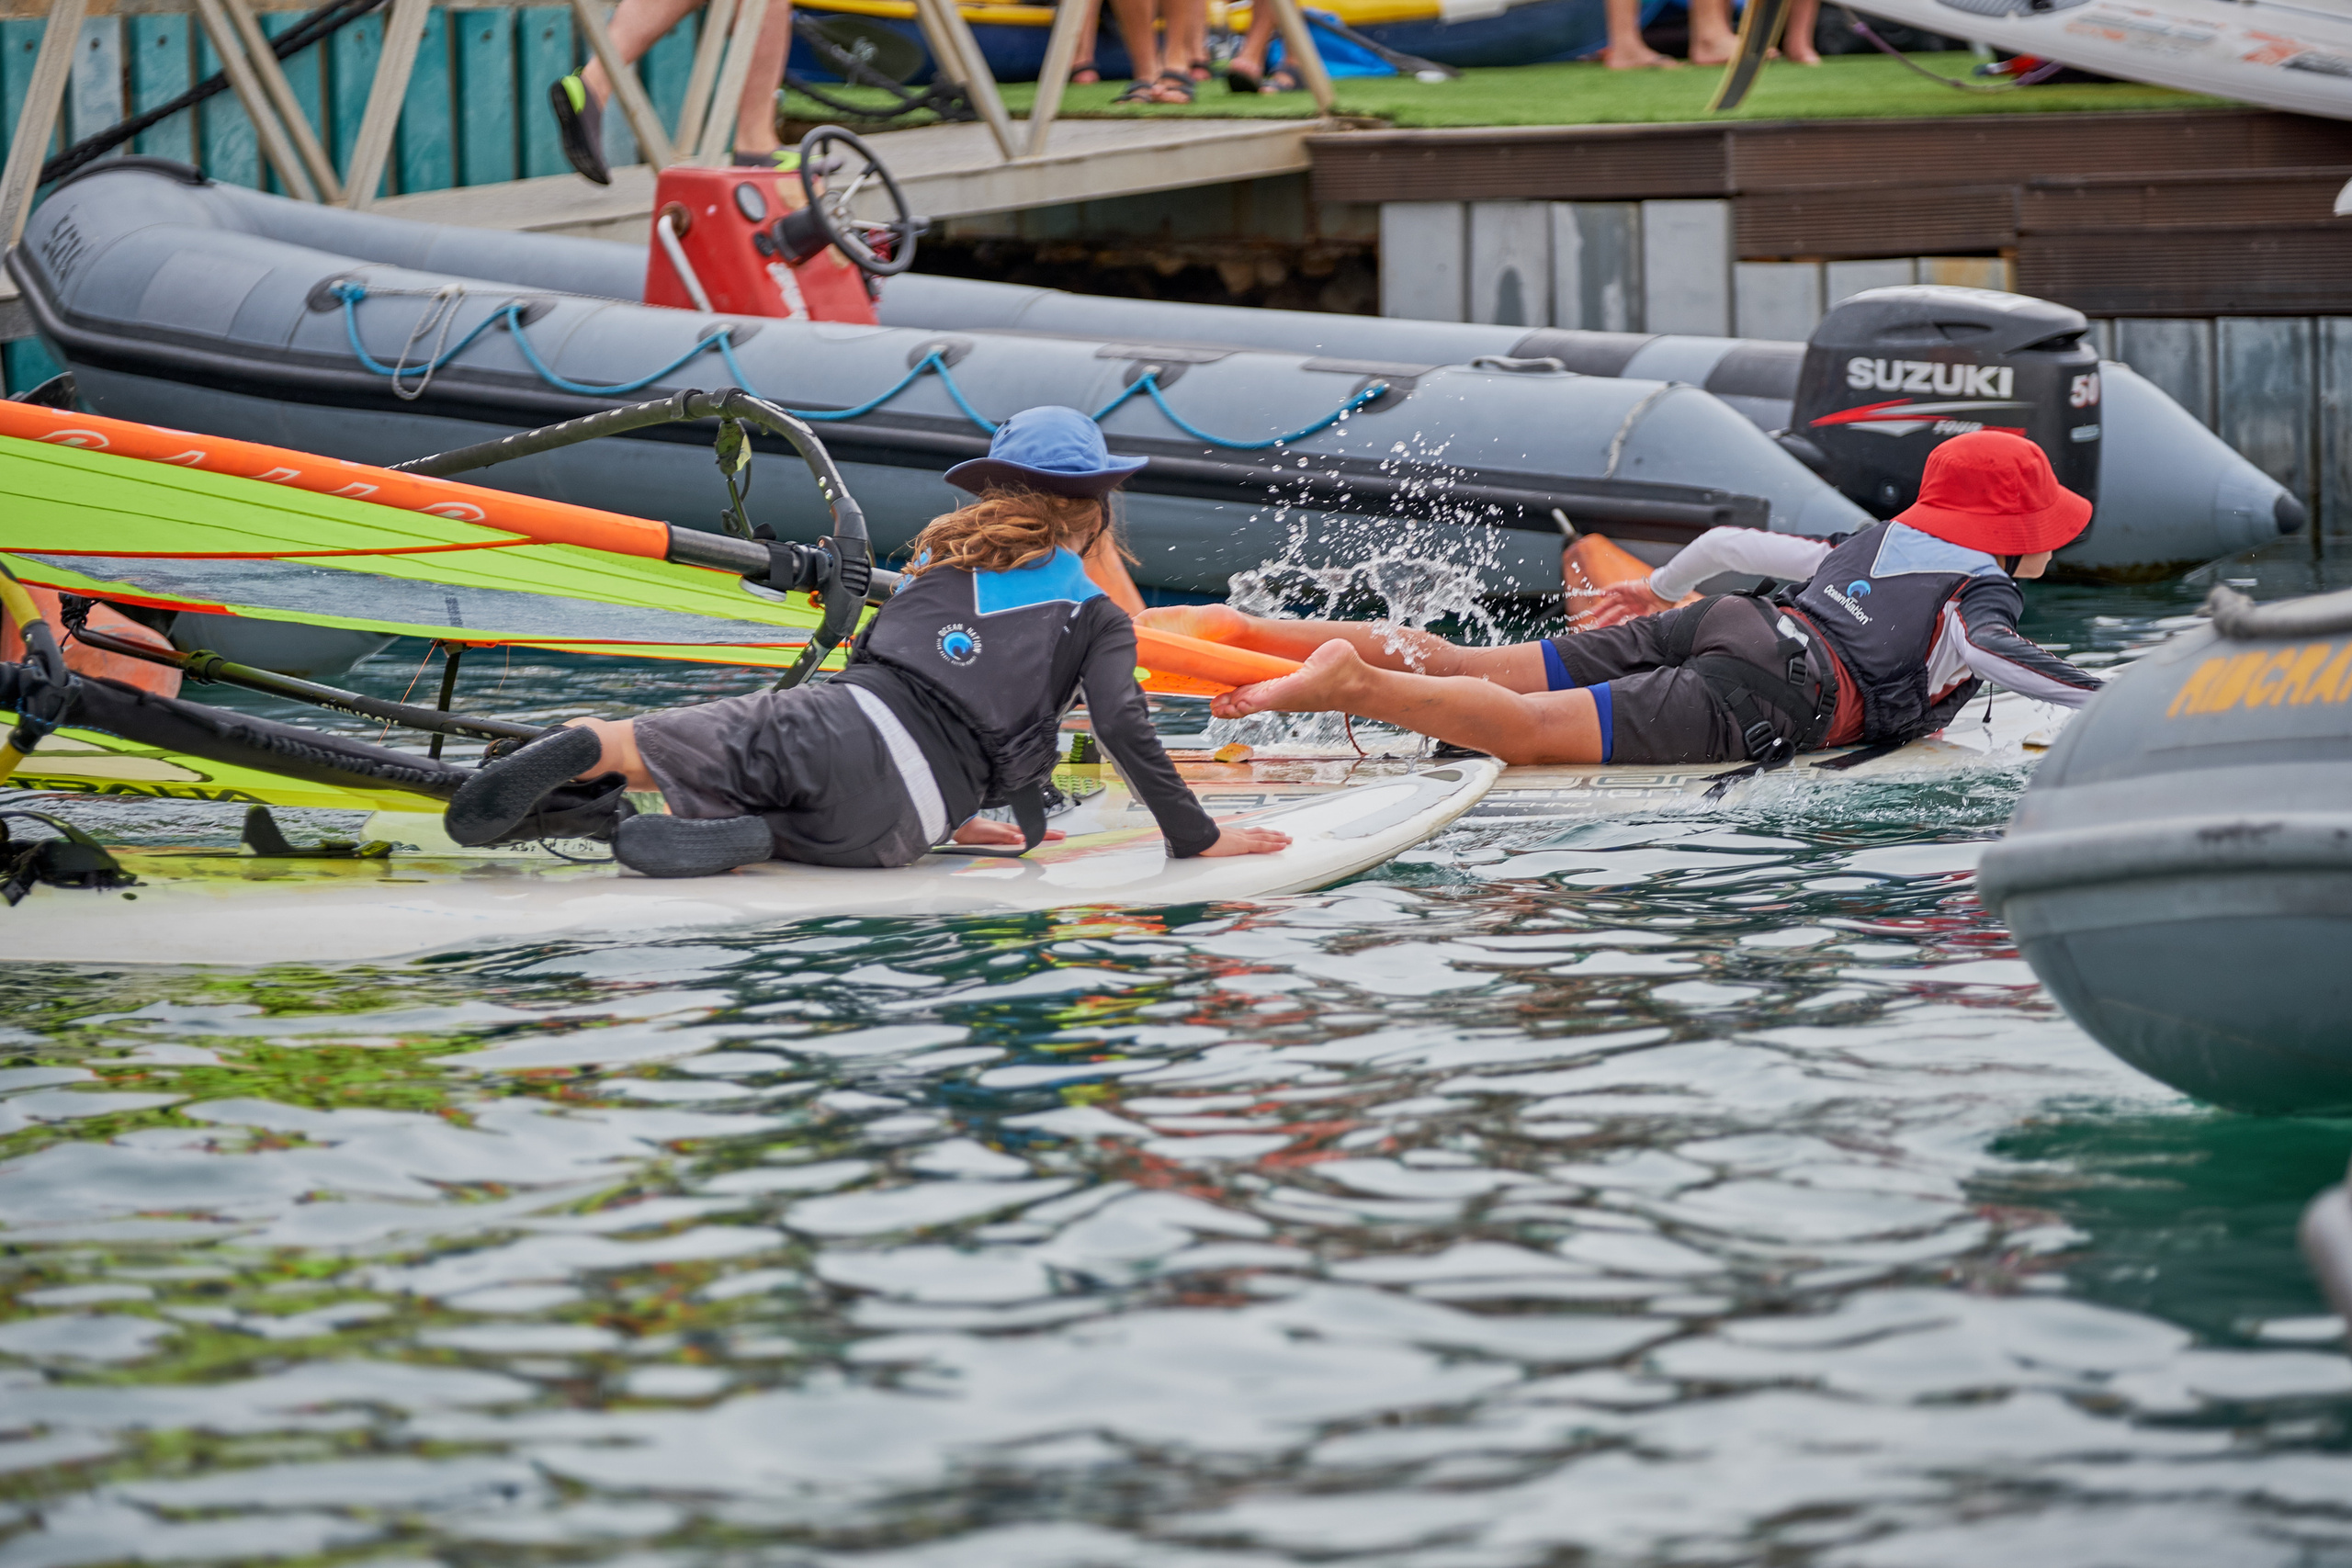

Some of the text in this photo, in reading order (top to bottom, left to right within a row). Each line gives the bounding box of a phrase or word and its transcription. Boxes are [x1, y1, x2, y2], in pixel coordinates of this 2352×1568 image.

[1846, 356, 2013, 398] SUZUKI
[938, 623, 964, 637] OCEAN
[965, 626, 982, 654] NATION
